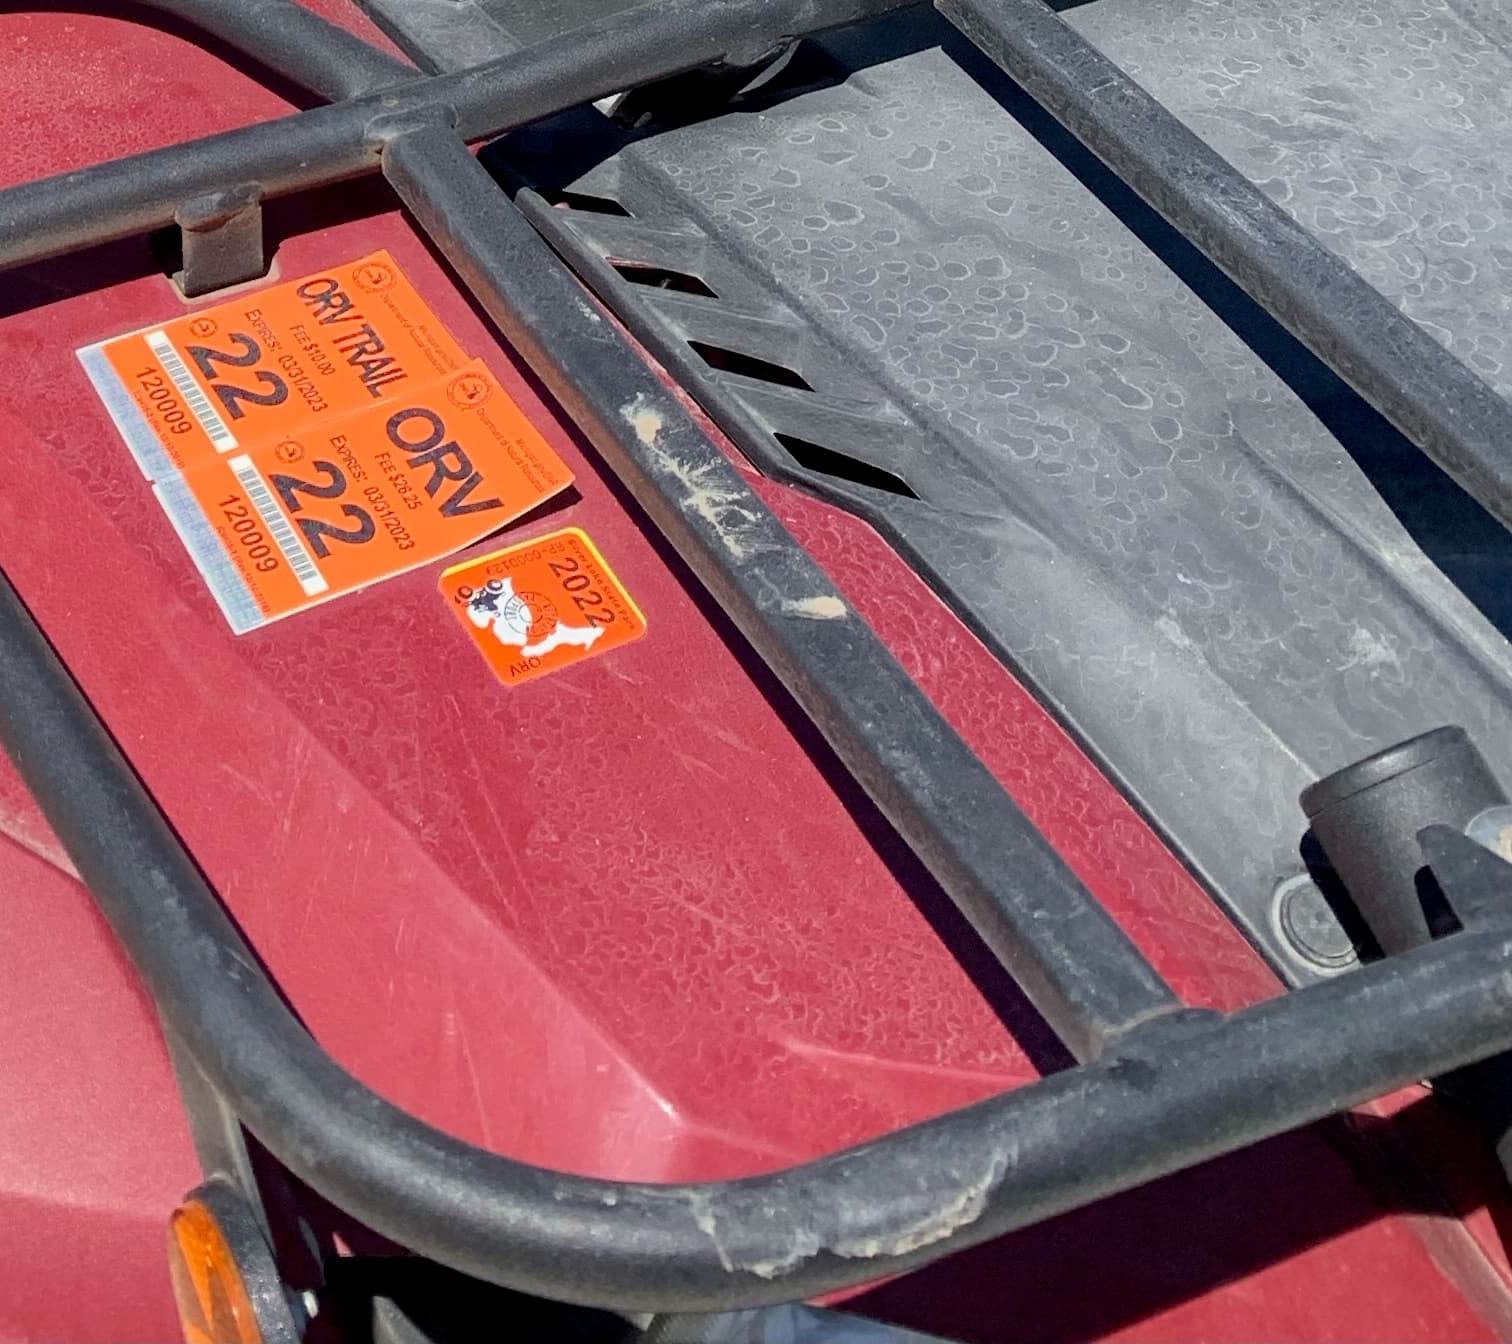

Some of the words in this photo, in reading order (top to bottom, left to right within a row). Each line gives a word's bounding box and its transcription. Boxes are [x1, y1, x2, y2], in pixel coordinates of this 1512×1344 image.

[289, 324, 310, 346] FEE
[302, 343, 336, 377] $10.00
[296, 277, 364, 326] ORV
[331, 323, 409, 400] TRAIL
[136, 366, 193, 435] 120009
[185, 333, 289, 420] 22
[374, 452, 396, 475] FEE
[388, 473, 424, 511] $26.25
[385, 407, 505, 519] ORV
[218, 494, 279, 573] 120009
[268, 460, 376, 560] 22
[362, 486, 416, 551] 03/31/2023
[547, 557, 616, 629] 2022
[586, 563, 603, 585] Lake
[510, 656, 542, 677] ORV
